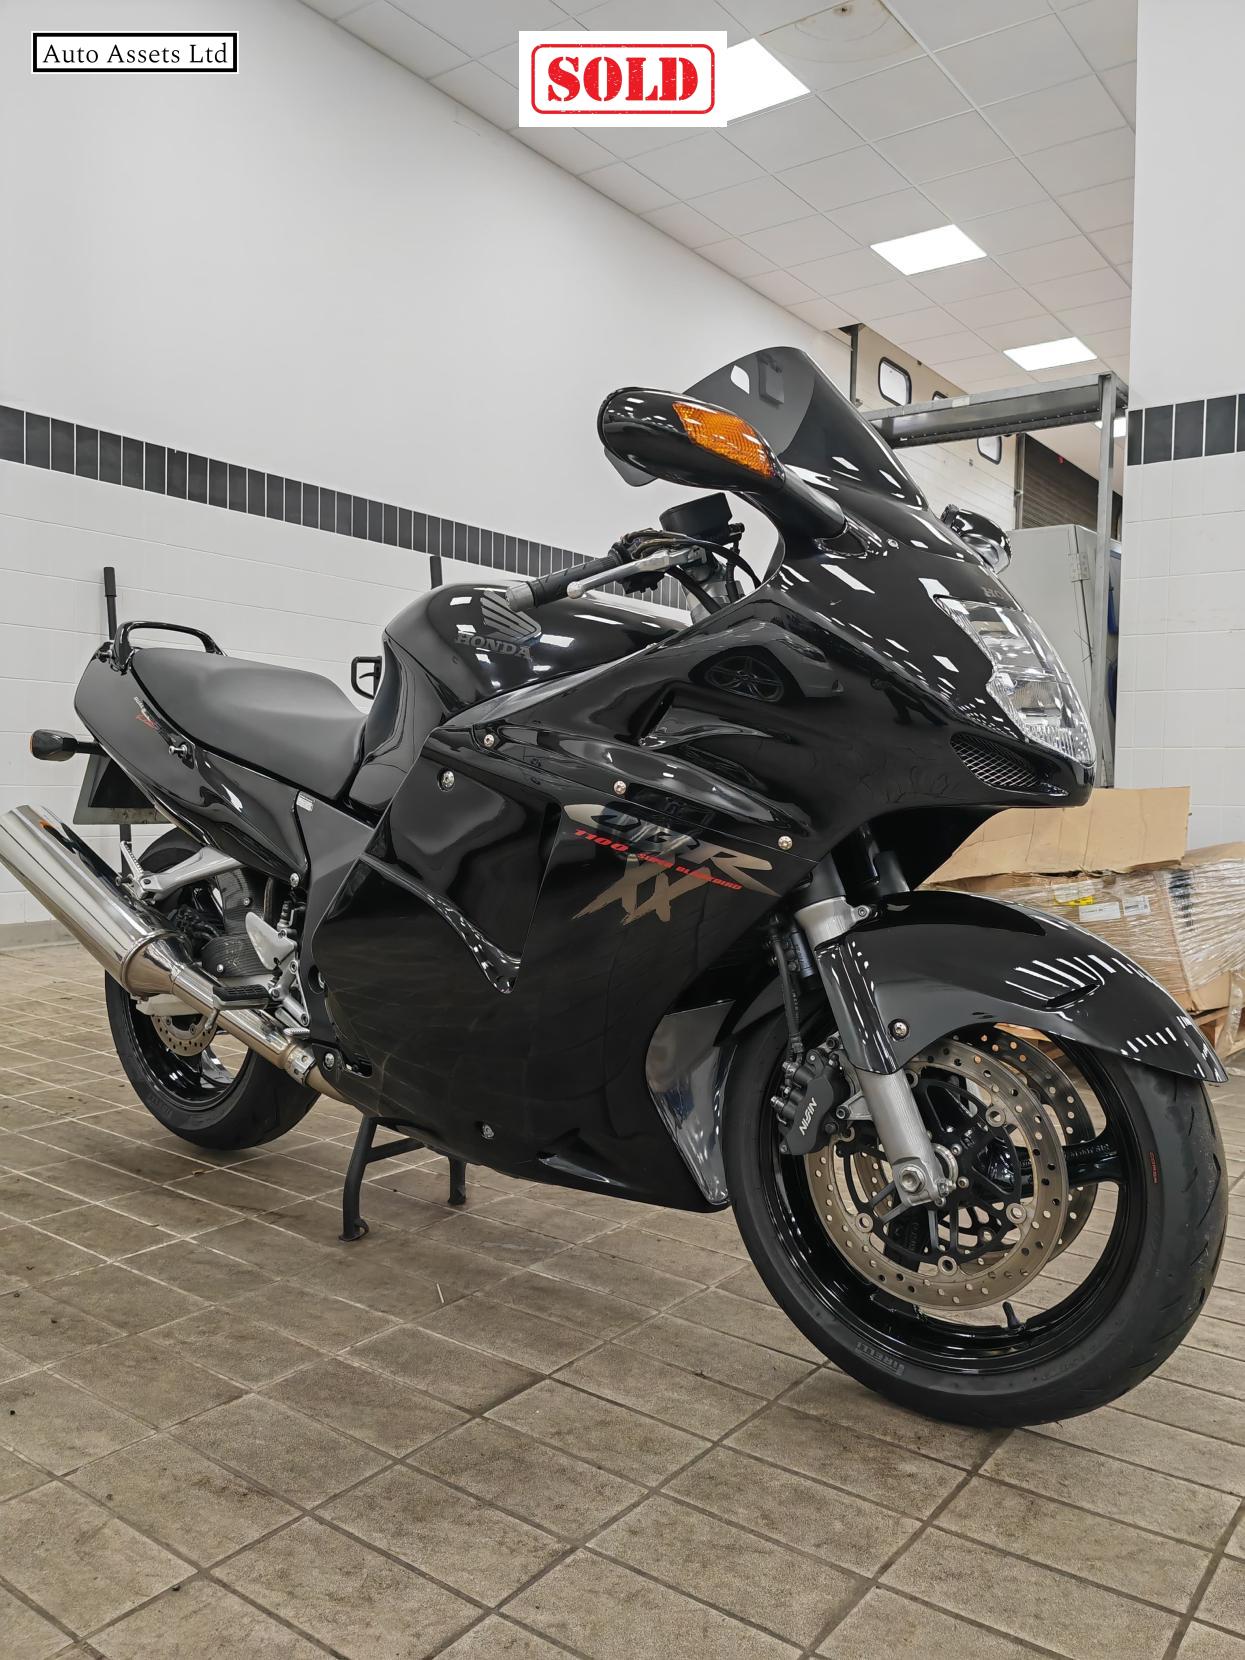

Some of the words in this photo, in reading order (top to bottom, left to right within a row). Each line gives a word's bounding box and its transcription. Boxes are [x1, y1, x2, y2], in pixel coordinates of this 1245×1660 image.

[455, 633, 533, 660] HONDA
[575, 829, 630, 852] 1100
[799, 1097, 817, 1136] NISSIN
